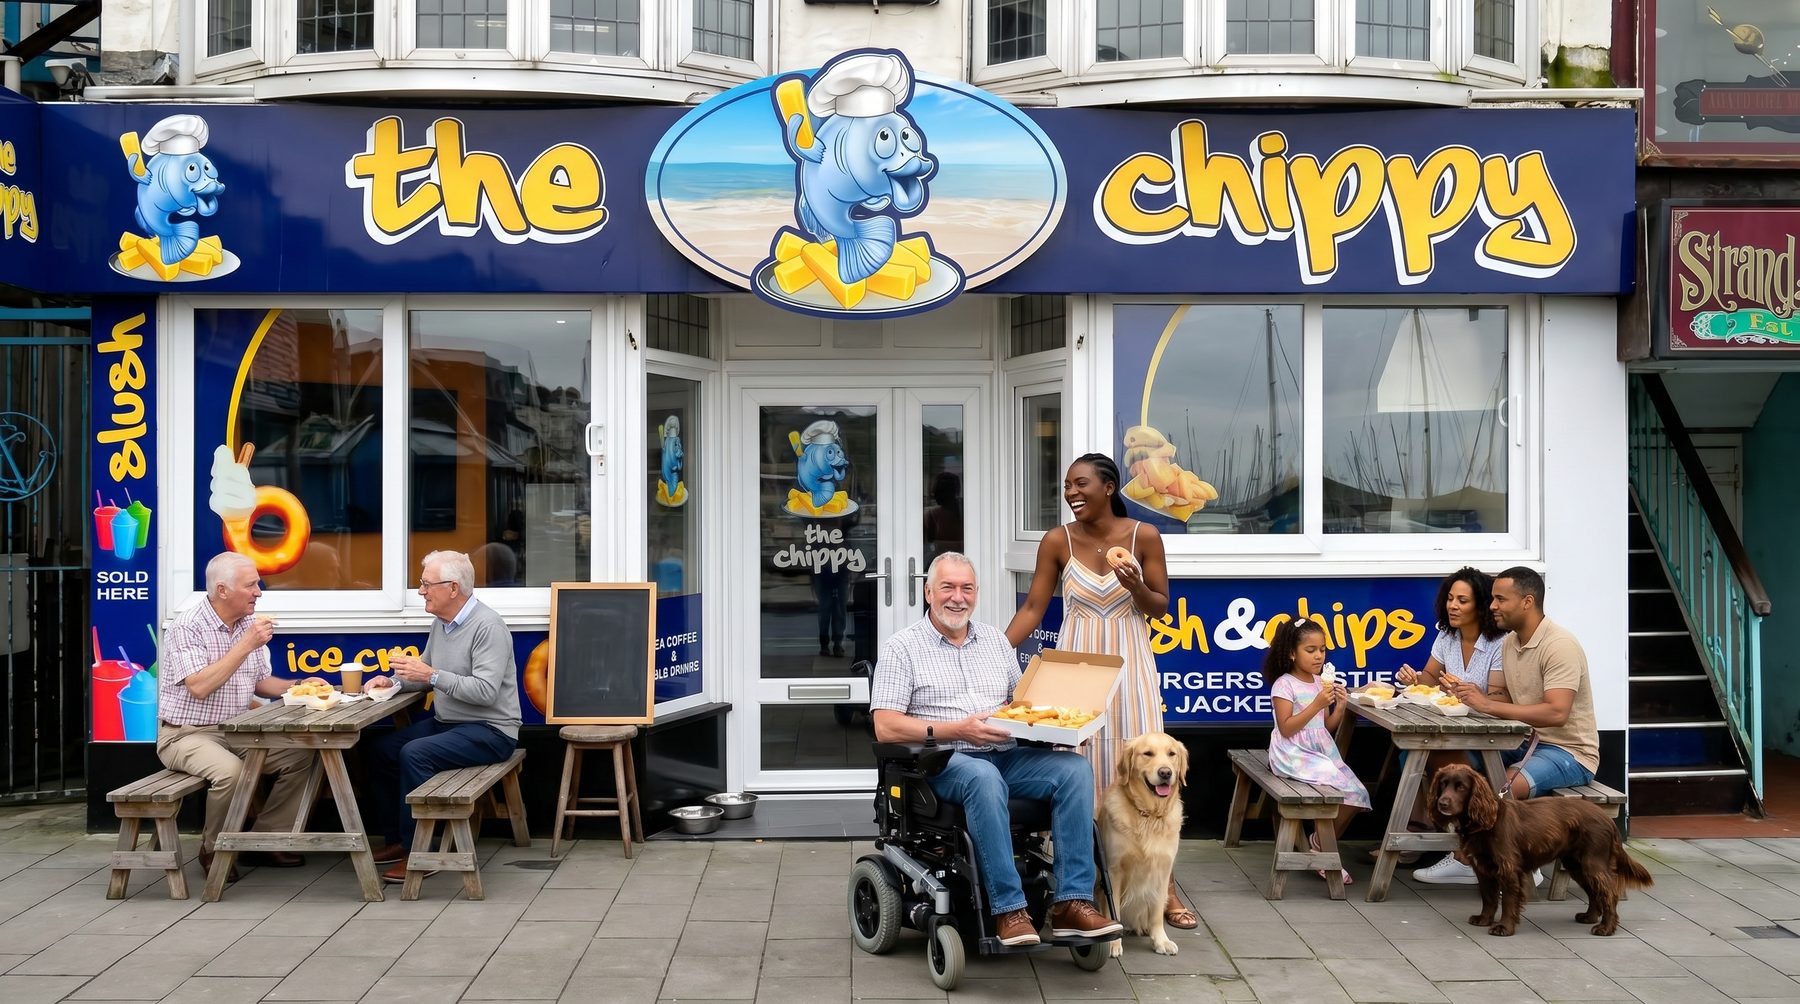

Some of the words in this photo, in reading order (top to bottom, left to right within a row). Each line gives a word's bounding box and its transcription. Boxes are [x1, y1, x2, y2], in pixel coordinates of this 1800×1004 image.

[345, 115, 610, 246] the
[1093, 118, 1577, 286] chippy
[1679, 230, 1800, 319] Strand
[97, 312, 147, 483] slush
[804, 523, 844, 544] the
[773, 544, 866, 574] chippy
[97, 571, 148, 584] SOLD
[97, 588, 149, 600] HERE
[1144, 597, 1210, 654] sh
[655, 637, 665, 650] EA
[667, 632, 697, 647] COFFEE
[286, 642, 343, 673] ice
[671, 651, 677, 662] &
[1157, 671, 1264, 689] RGERS
[1175, 695, 1272, 714] JACKE
